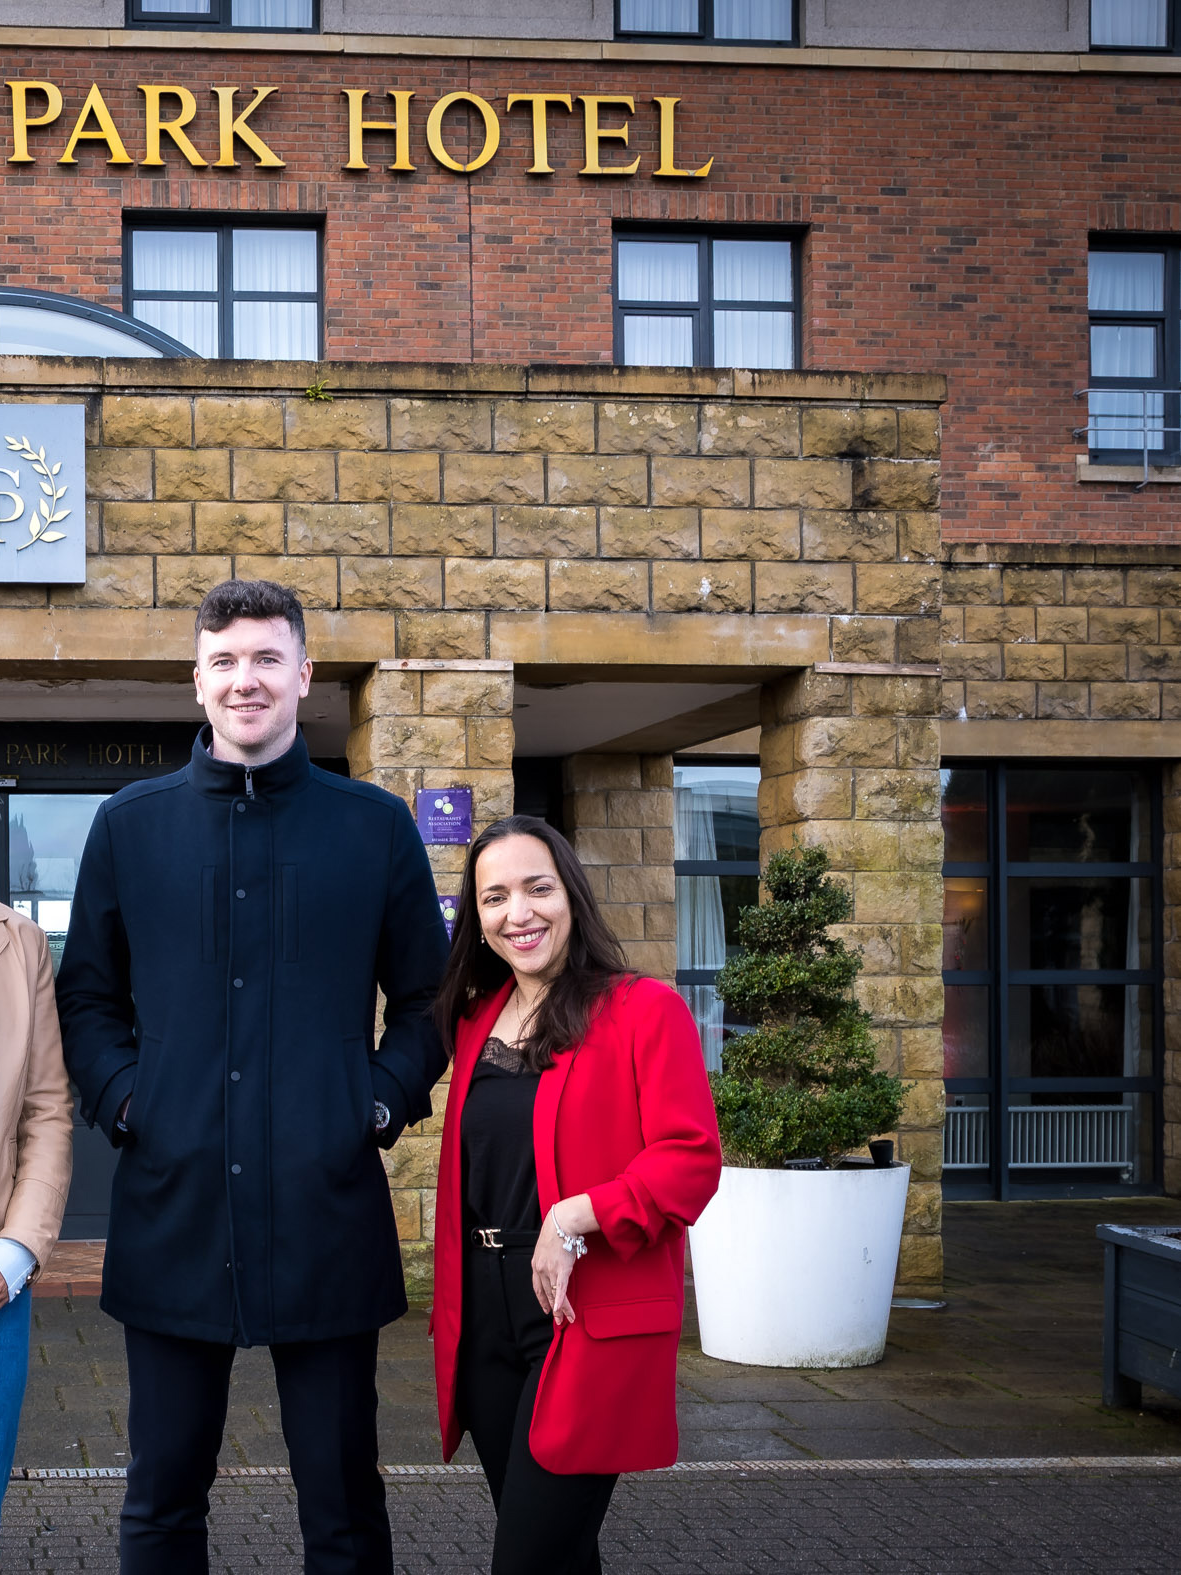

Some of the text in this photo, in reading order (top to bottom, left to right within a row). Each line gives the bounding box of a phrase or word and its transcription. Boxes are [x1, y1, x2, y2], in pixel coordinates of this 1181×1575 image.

[4, 80, 287, 169] PARK
[340, 88, 716, 178] HOTEL
[6, 743, 171, 765] PARK HOTEL
